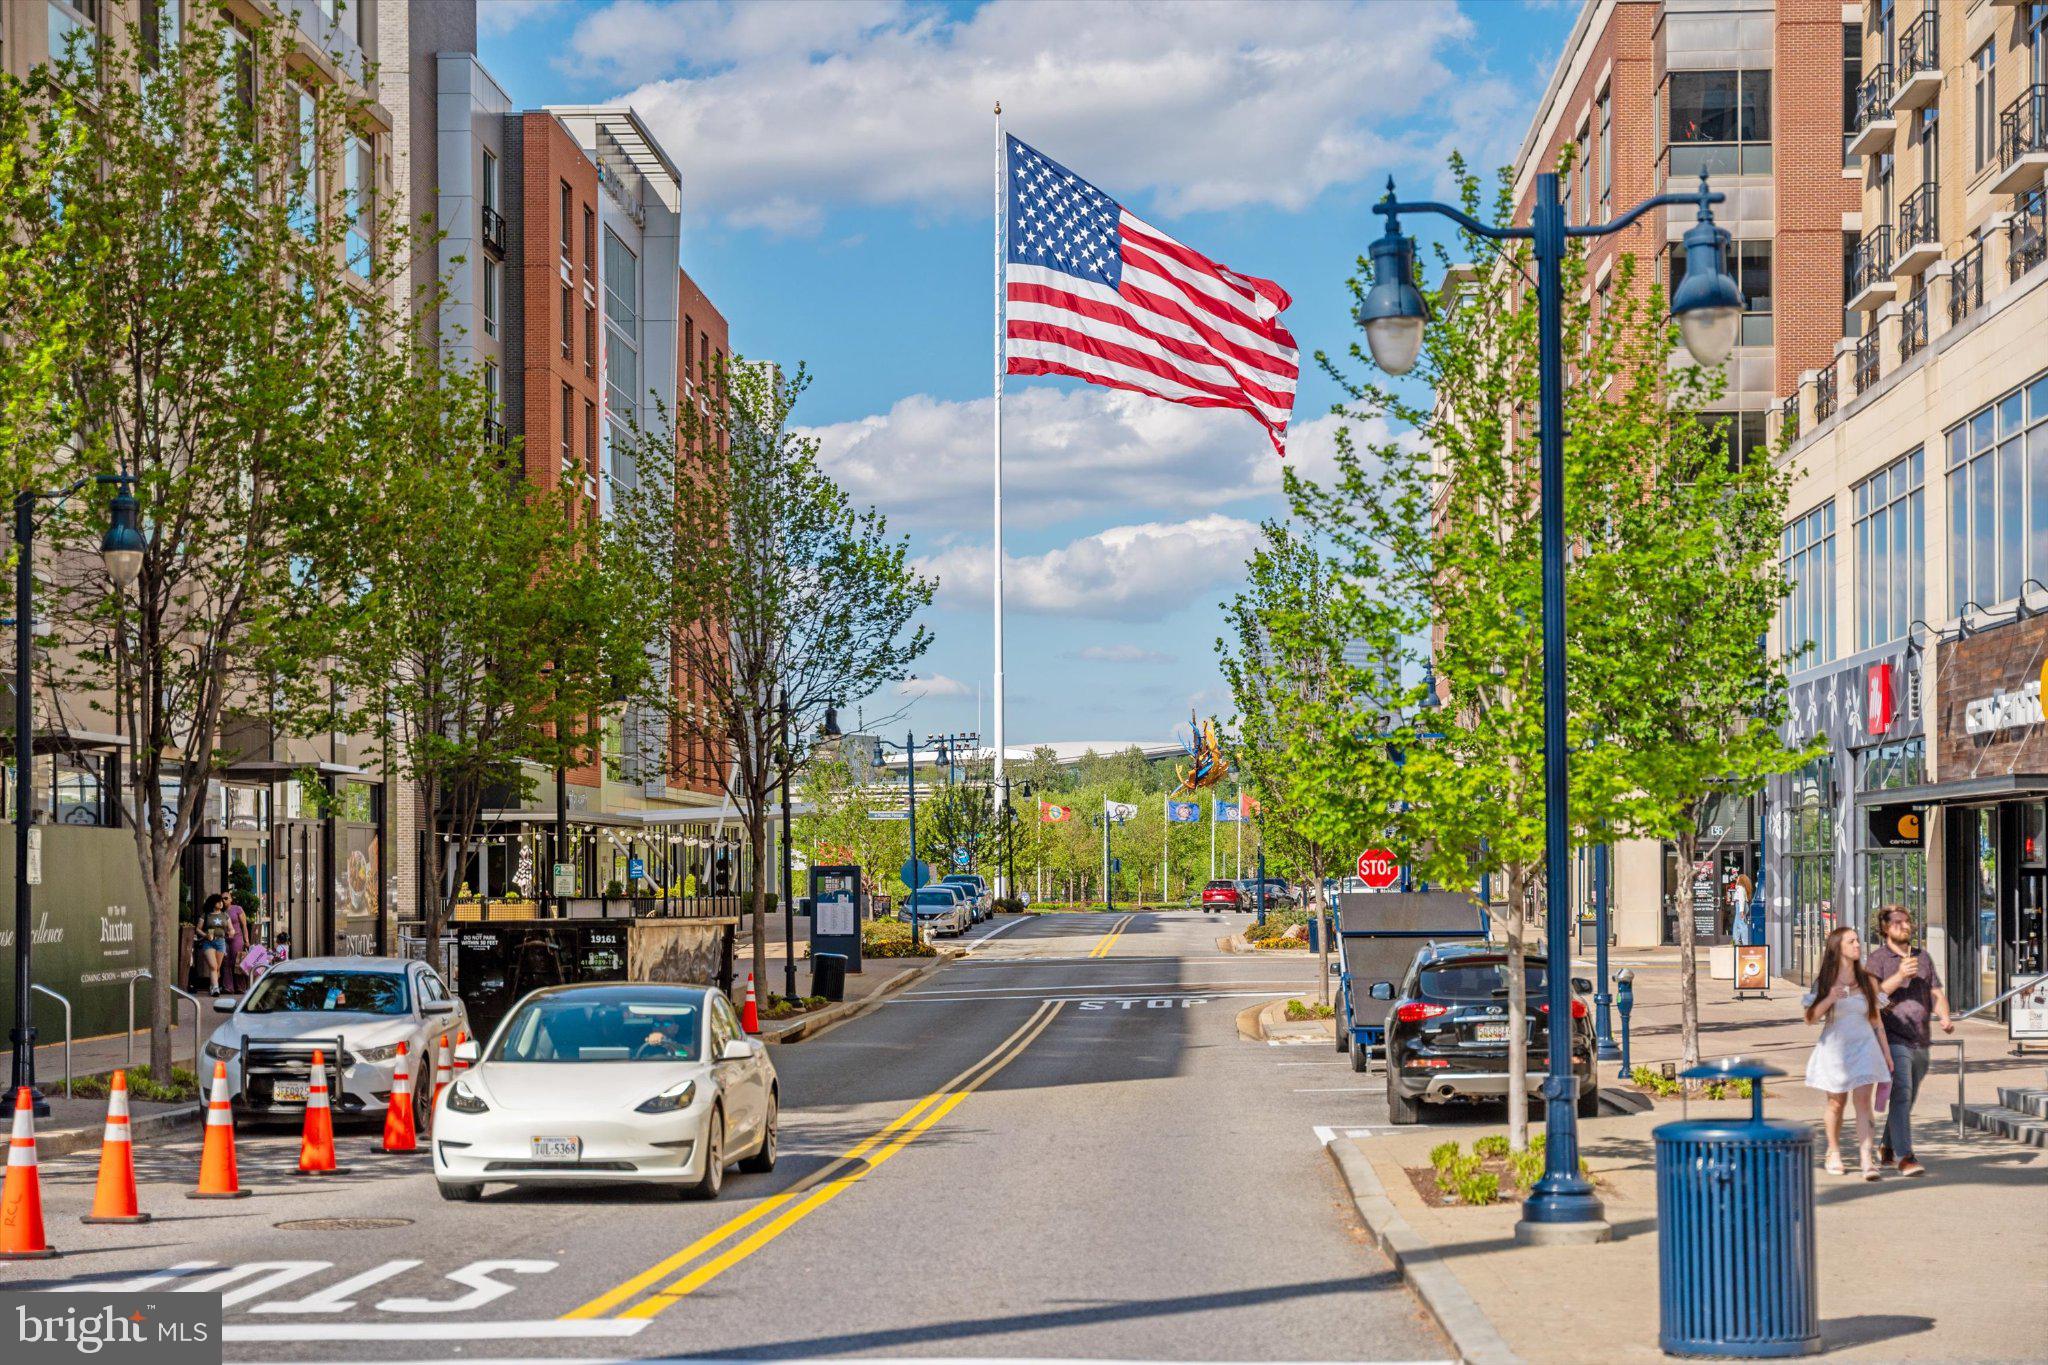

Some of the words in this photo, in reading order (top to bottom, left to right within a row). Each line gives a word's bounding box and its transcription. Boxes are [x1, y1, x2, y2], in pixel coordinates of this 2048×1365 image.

[100, 916, 133, 943] Ruxton
[591, 935, 617, 944] 19161
[1079, 999, 1207, 1010] STOP
